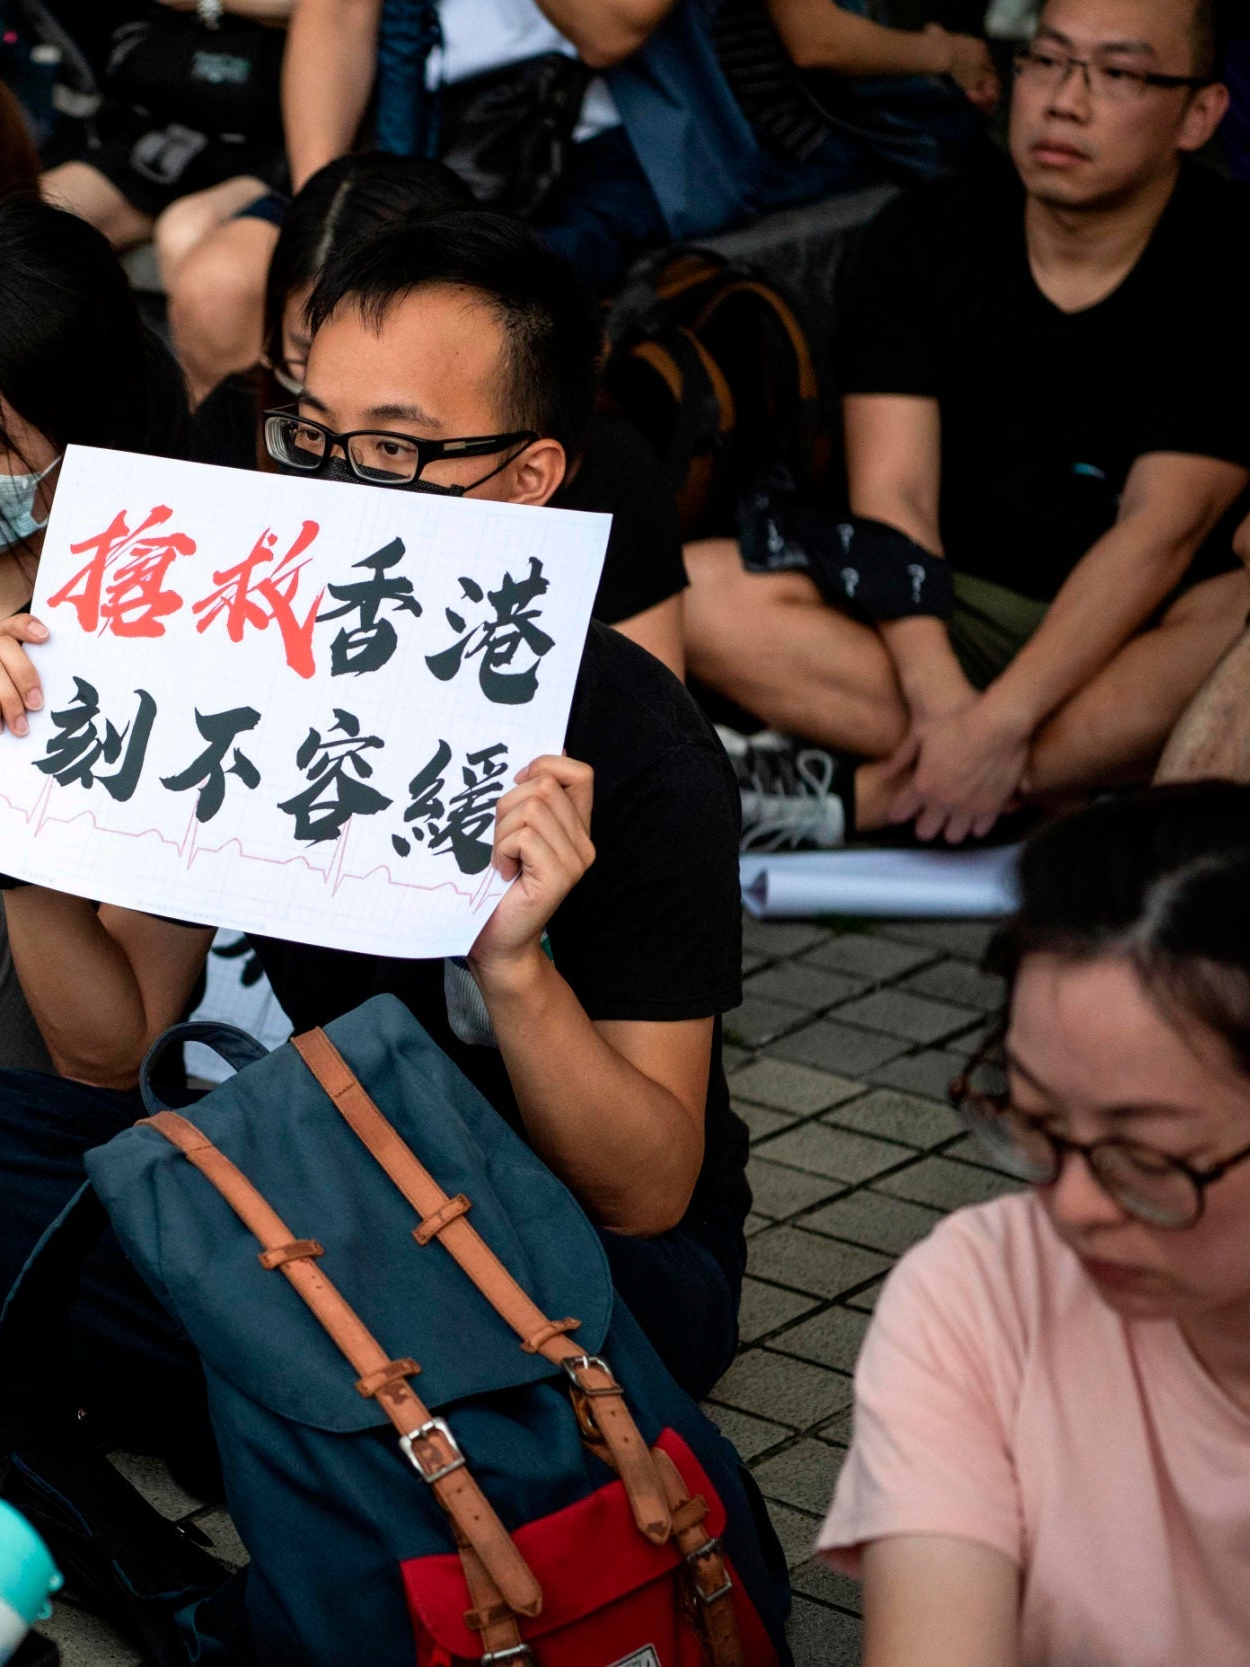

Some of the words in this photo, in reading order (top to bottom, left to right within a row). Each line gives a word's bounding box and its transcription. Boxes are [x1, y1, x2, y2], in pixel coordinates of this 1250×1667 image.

[48, 506, 555, 704] 搶救香港
[32, 677, 507, 874] 刻不容緩
